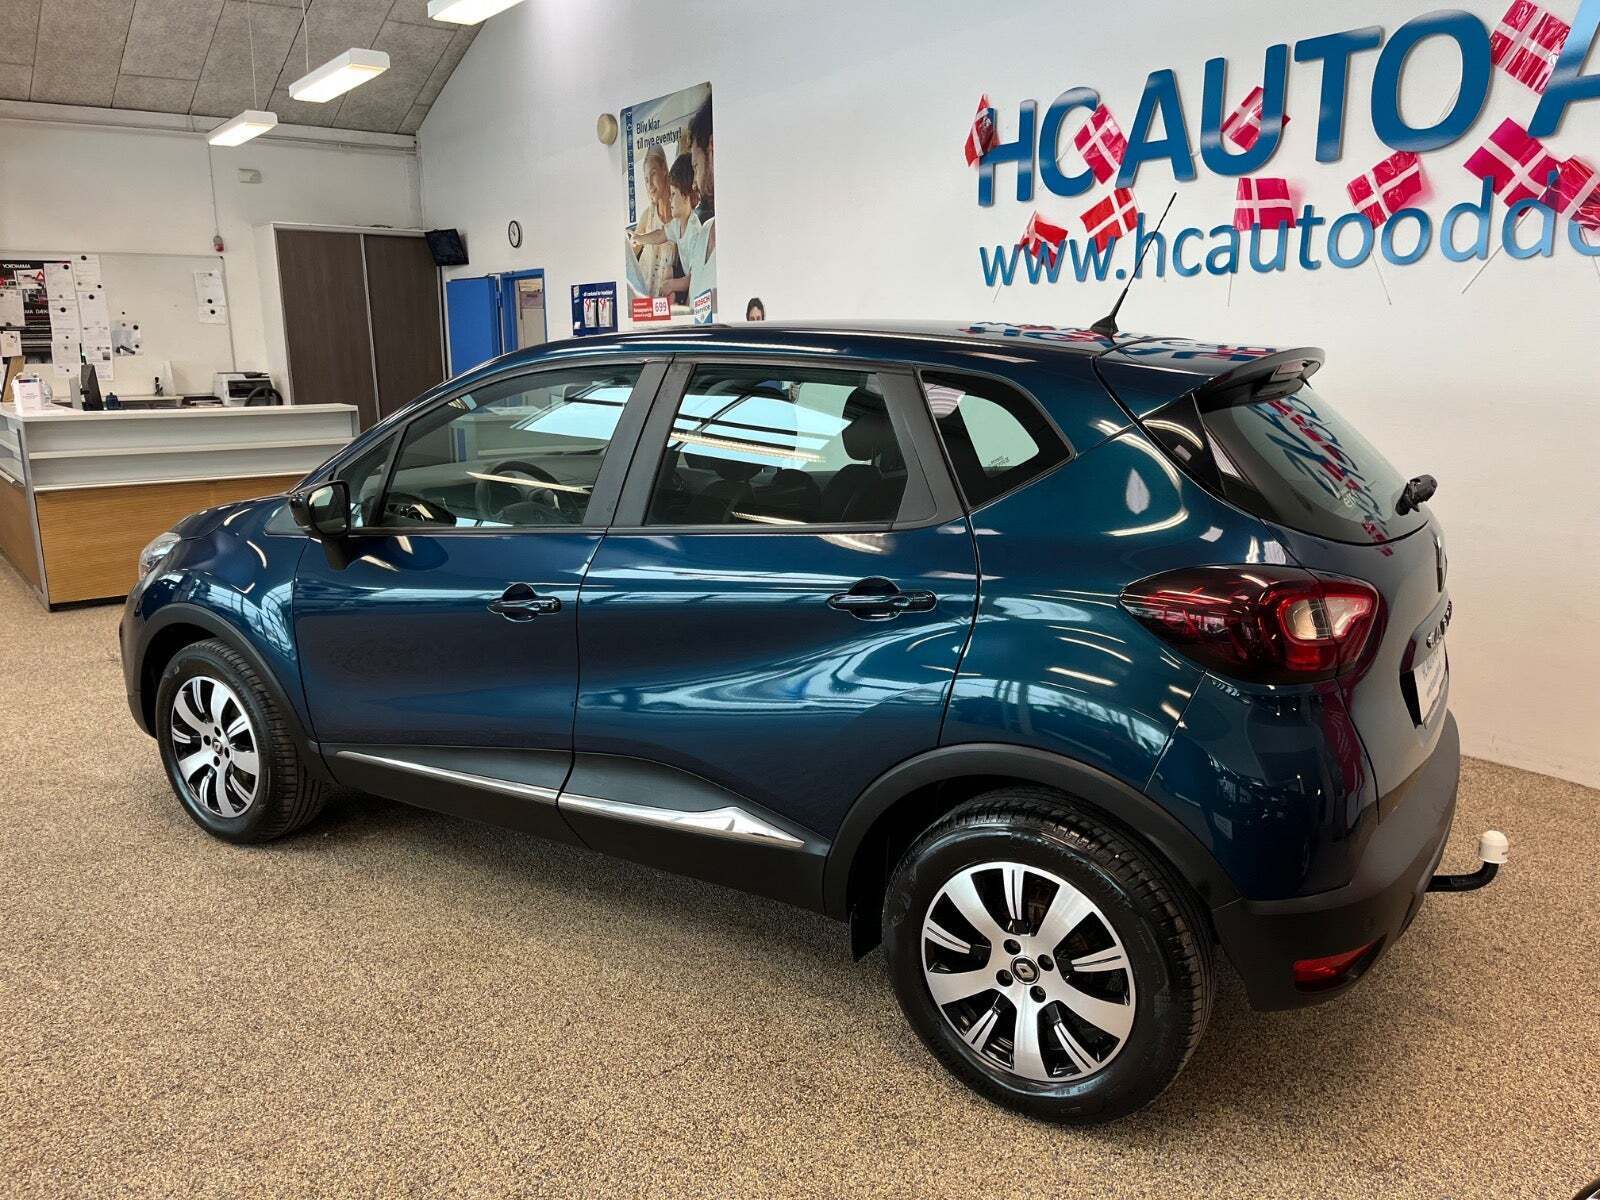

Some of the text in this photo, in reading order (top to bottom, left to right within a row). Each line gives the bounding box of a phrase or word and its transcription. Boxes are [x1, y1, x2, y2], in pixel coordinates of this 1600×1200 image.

[636, 117, 660, 134] Bliv klar
[644, 137, 655, 149] nye
[655, 127, 682, 143] eventyr!
[655, 301, 667, 313] 699
